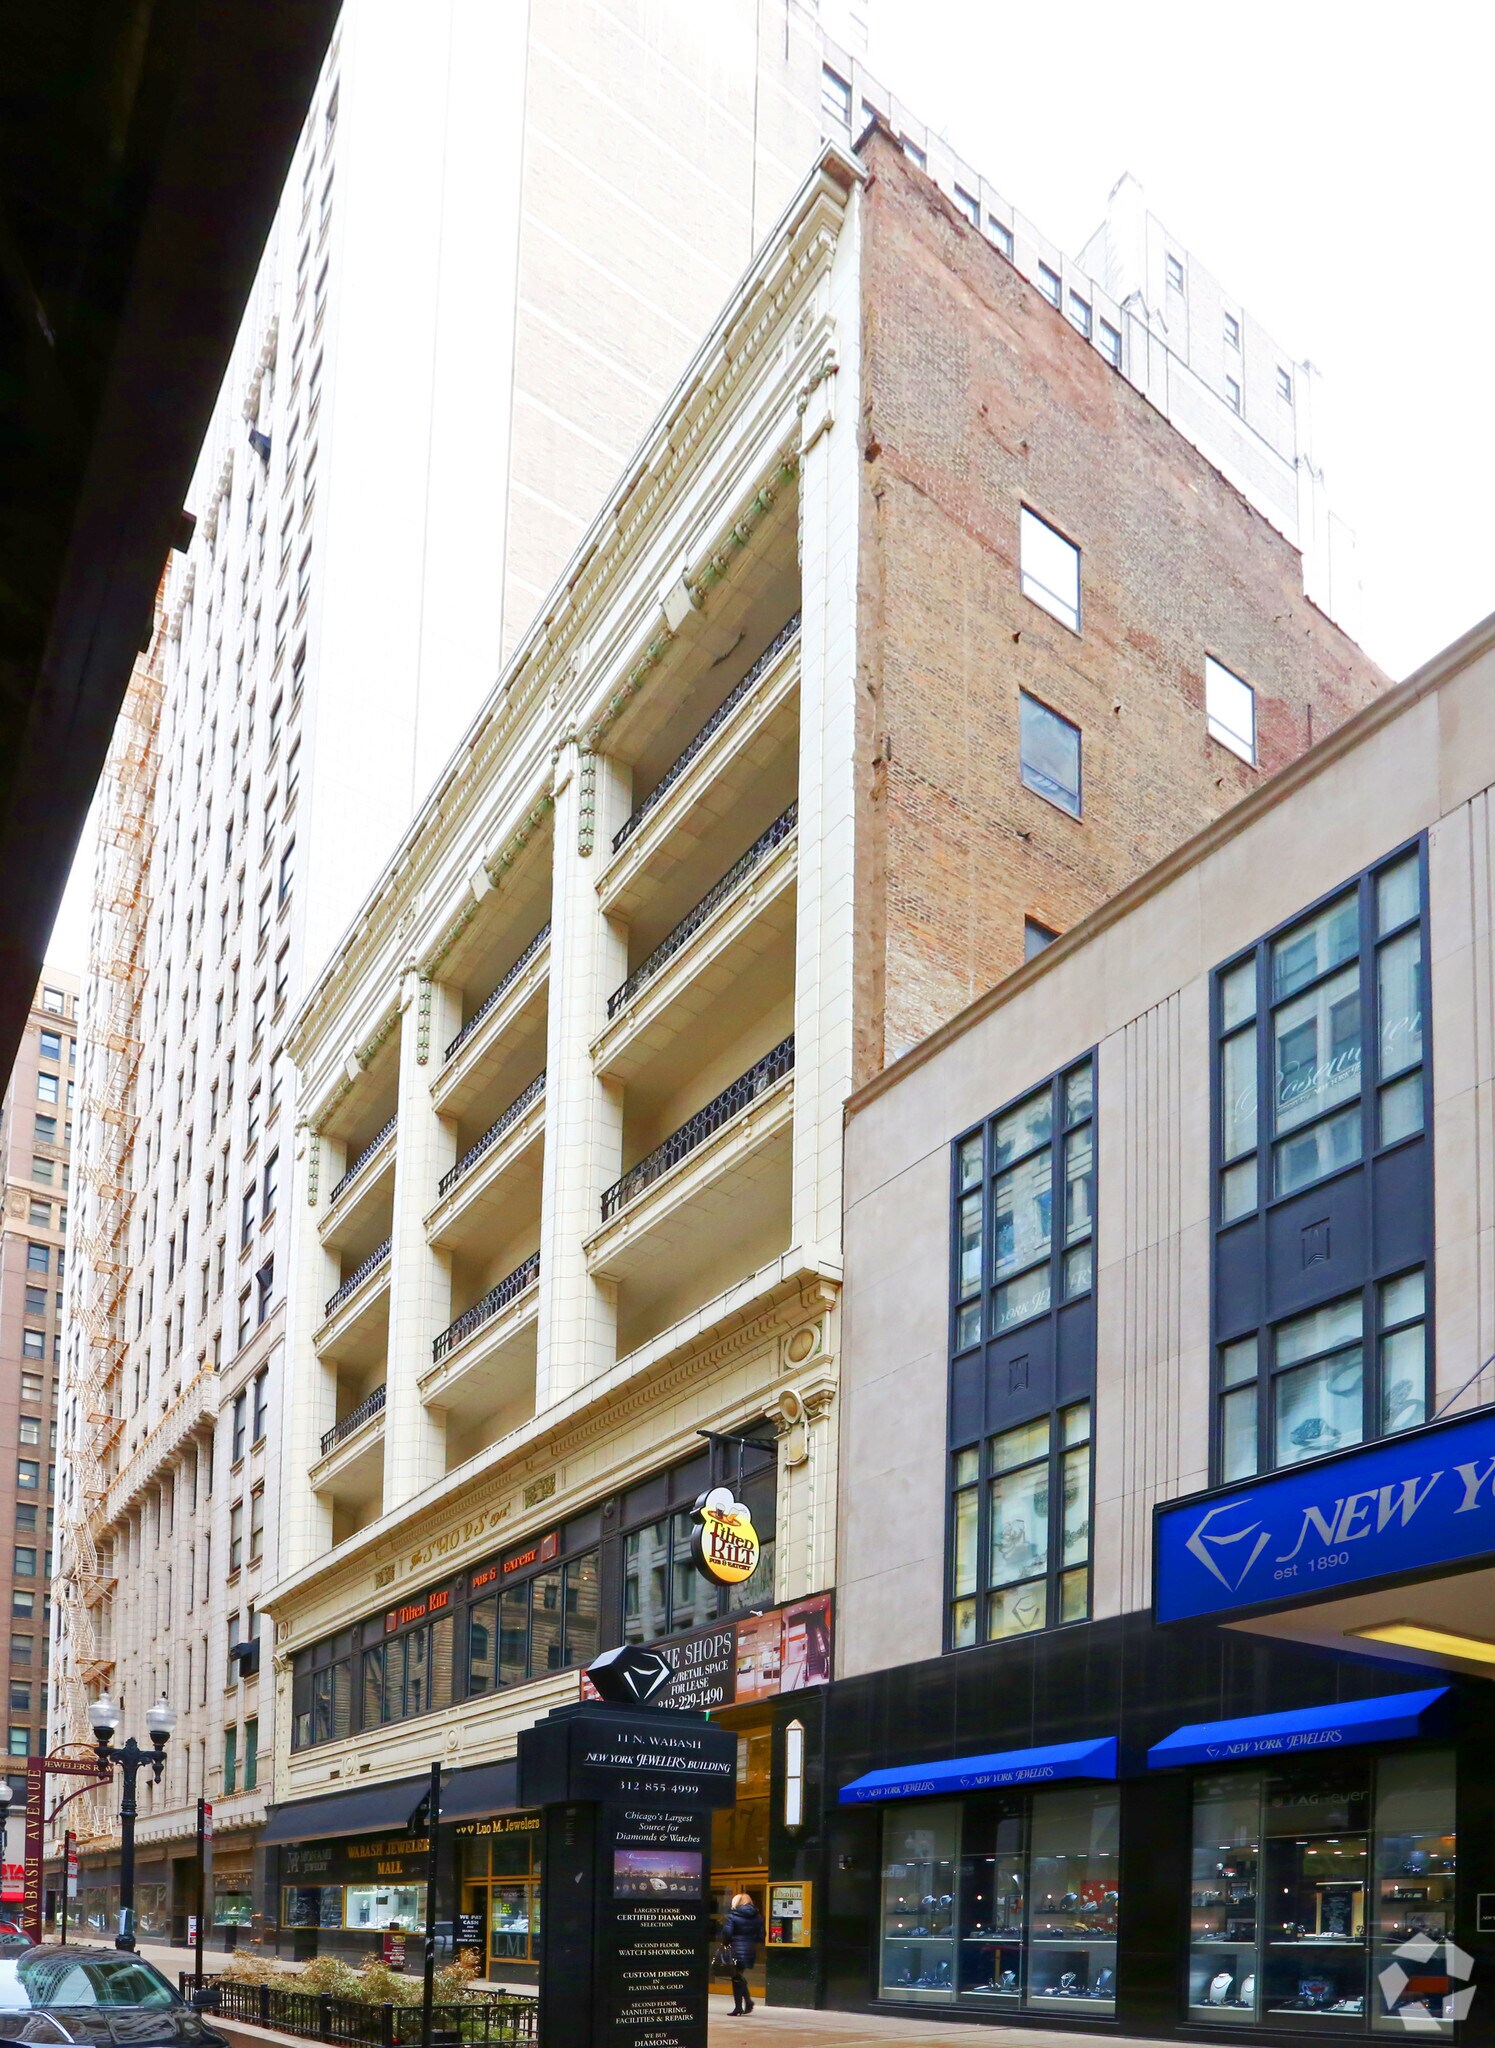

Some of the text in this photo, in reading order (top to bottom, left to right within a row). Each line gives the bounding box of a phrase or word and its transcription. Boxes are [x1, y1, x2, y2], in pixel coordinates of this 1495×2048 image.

[1275, 1455, 1495, 1563] NEW Y
[423, 1510, 490, 1564] SHOPS
[1273, 1551, 1350, 1580] est 1890
[685, 1632, 731, 1665] SHOPS
[705, 1660, 728, 1675] SPACE
[671, 1677, 709, 1695] FOR LEASE
[633, 1735, 645, 1744] N.
[649, 1736, 702, 1749] WABASH
[1222, 1729, 1343, 1756] NEW YORK JEWELERS
[44, 1761, 91, 1771] JEWELERS
[585, 1752, 731, 1773] NEW YORK JEWELERS BUILDING
[993, 1772, 1013, 1782] YORK
[1015, 1766, 1054, 1781] JEWELERS
[620, 1781, 640, 1790] 312
[882, 1786, 900, 1795] YORK
[902, 1781, 935, 1794] JEWELERS
[27, 1769, 41, 1840] AVENUE
[624, 1811, 692, 1823] Chicago's Largest
[505, 1817, 540, 1832] Jewelers
[639, 1822, 680, 1833] Source for
[616, 1832, 700, 1843] Diamonds & Watches
[347, 1846, 383, 1858] WABASH
[377, 1861, 403, 1875] MALL
[24, 1857, 38, 1928] WABASH
[621, 2007, 686, 2016] MANUFACTURING
[665, 2014, 693, 2022] REPAIRS
[635, 2038, 679, 2047] DIAMONDS
